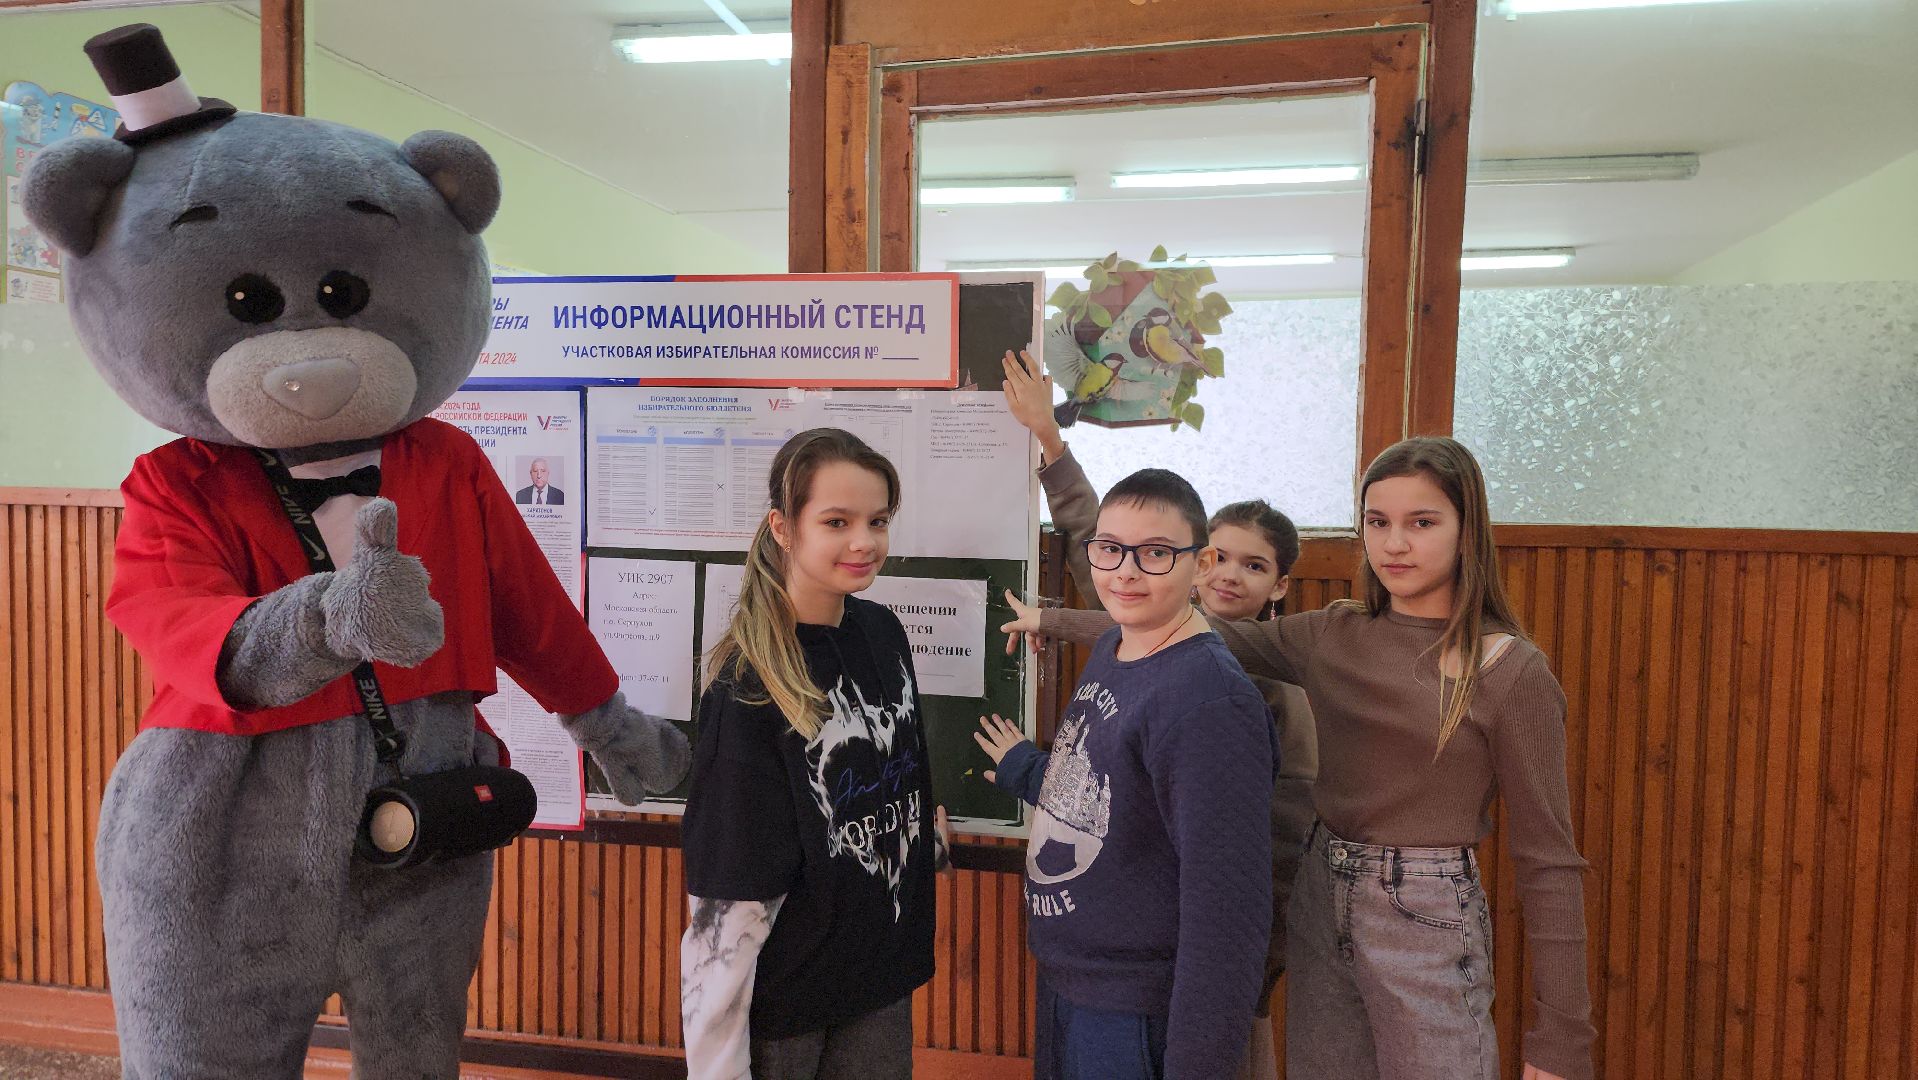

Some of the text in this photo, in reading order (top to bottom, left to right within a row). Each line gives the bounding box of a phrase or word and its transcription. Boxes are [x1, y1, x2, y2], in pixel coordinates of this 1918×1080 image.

[554, 298, 926, 335] ИНФОРМАЦИОННЫЙ СТЕНД
[562, 345, 652, 358] УЧАСТКОВАЯ
[656, 345, 776, 359] ИЗБИРАТЕЛЬНАЯ
[781, 346, 860, 359] КОМИССИЯ
[491, 353, 517, 365] 2024
[444, 402, 461, 410] 2024
[462, 402, 481, 411] ГОДА
[483, 411, 528, 422] ФЕДЕРАЦИИ
[474, 425, 528, 437] ПРЕЗИДЕНТА
[618, 572, 674, 585] УИК 2907
[604, 603, 678, 614] Московская область
[883, 603, 957, 616] мещении
[617, 617, 653, 628] Серпухов
[359, 678, 387, 720] NIKE
[1096, 688, 1119, 721] CITY
[1032, 889, 1076, 917] RULE
